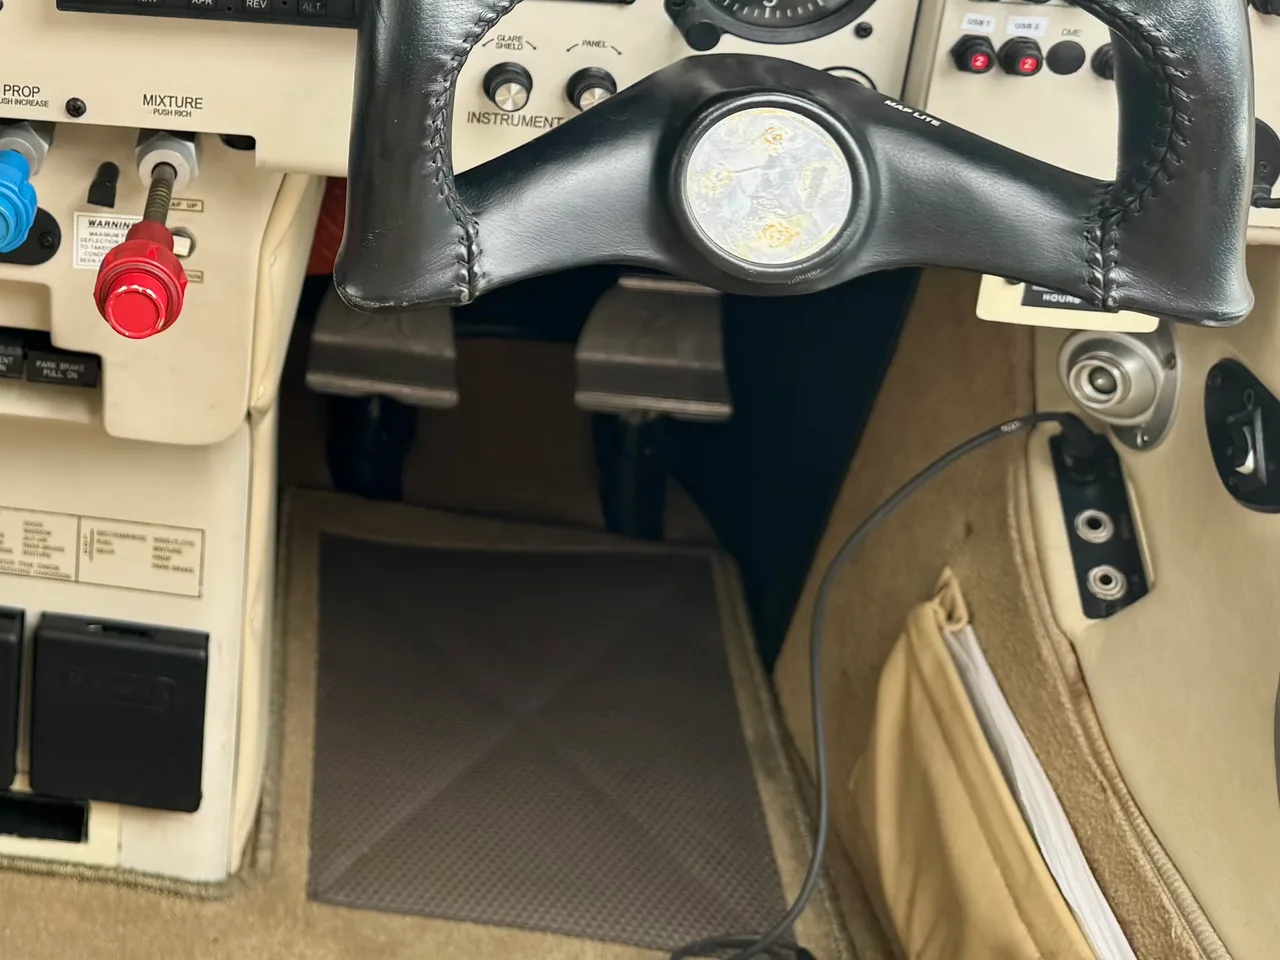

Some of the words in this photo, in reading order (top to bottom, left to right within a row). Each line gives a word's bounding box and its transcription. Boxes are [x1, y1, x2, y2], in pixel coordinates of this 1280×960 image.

[582, 40, 607, 48] PANEL
[3, 84, 41, 99] PROP
[143, 93, 203, 110] MIXTURE
[467, 111, 564, 129] INSTRUMENT
[884, 100, 913, 113] MAP
[913, 112, 941, 127] LITE
